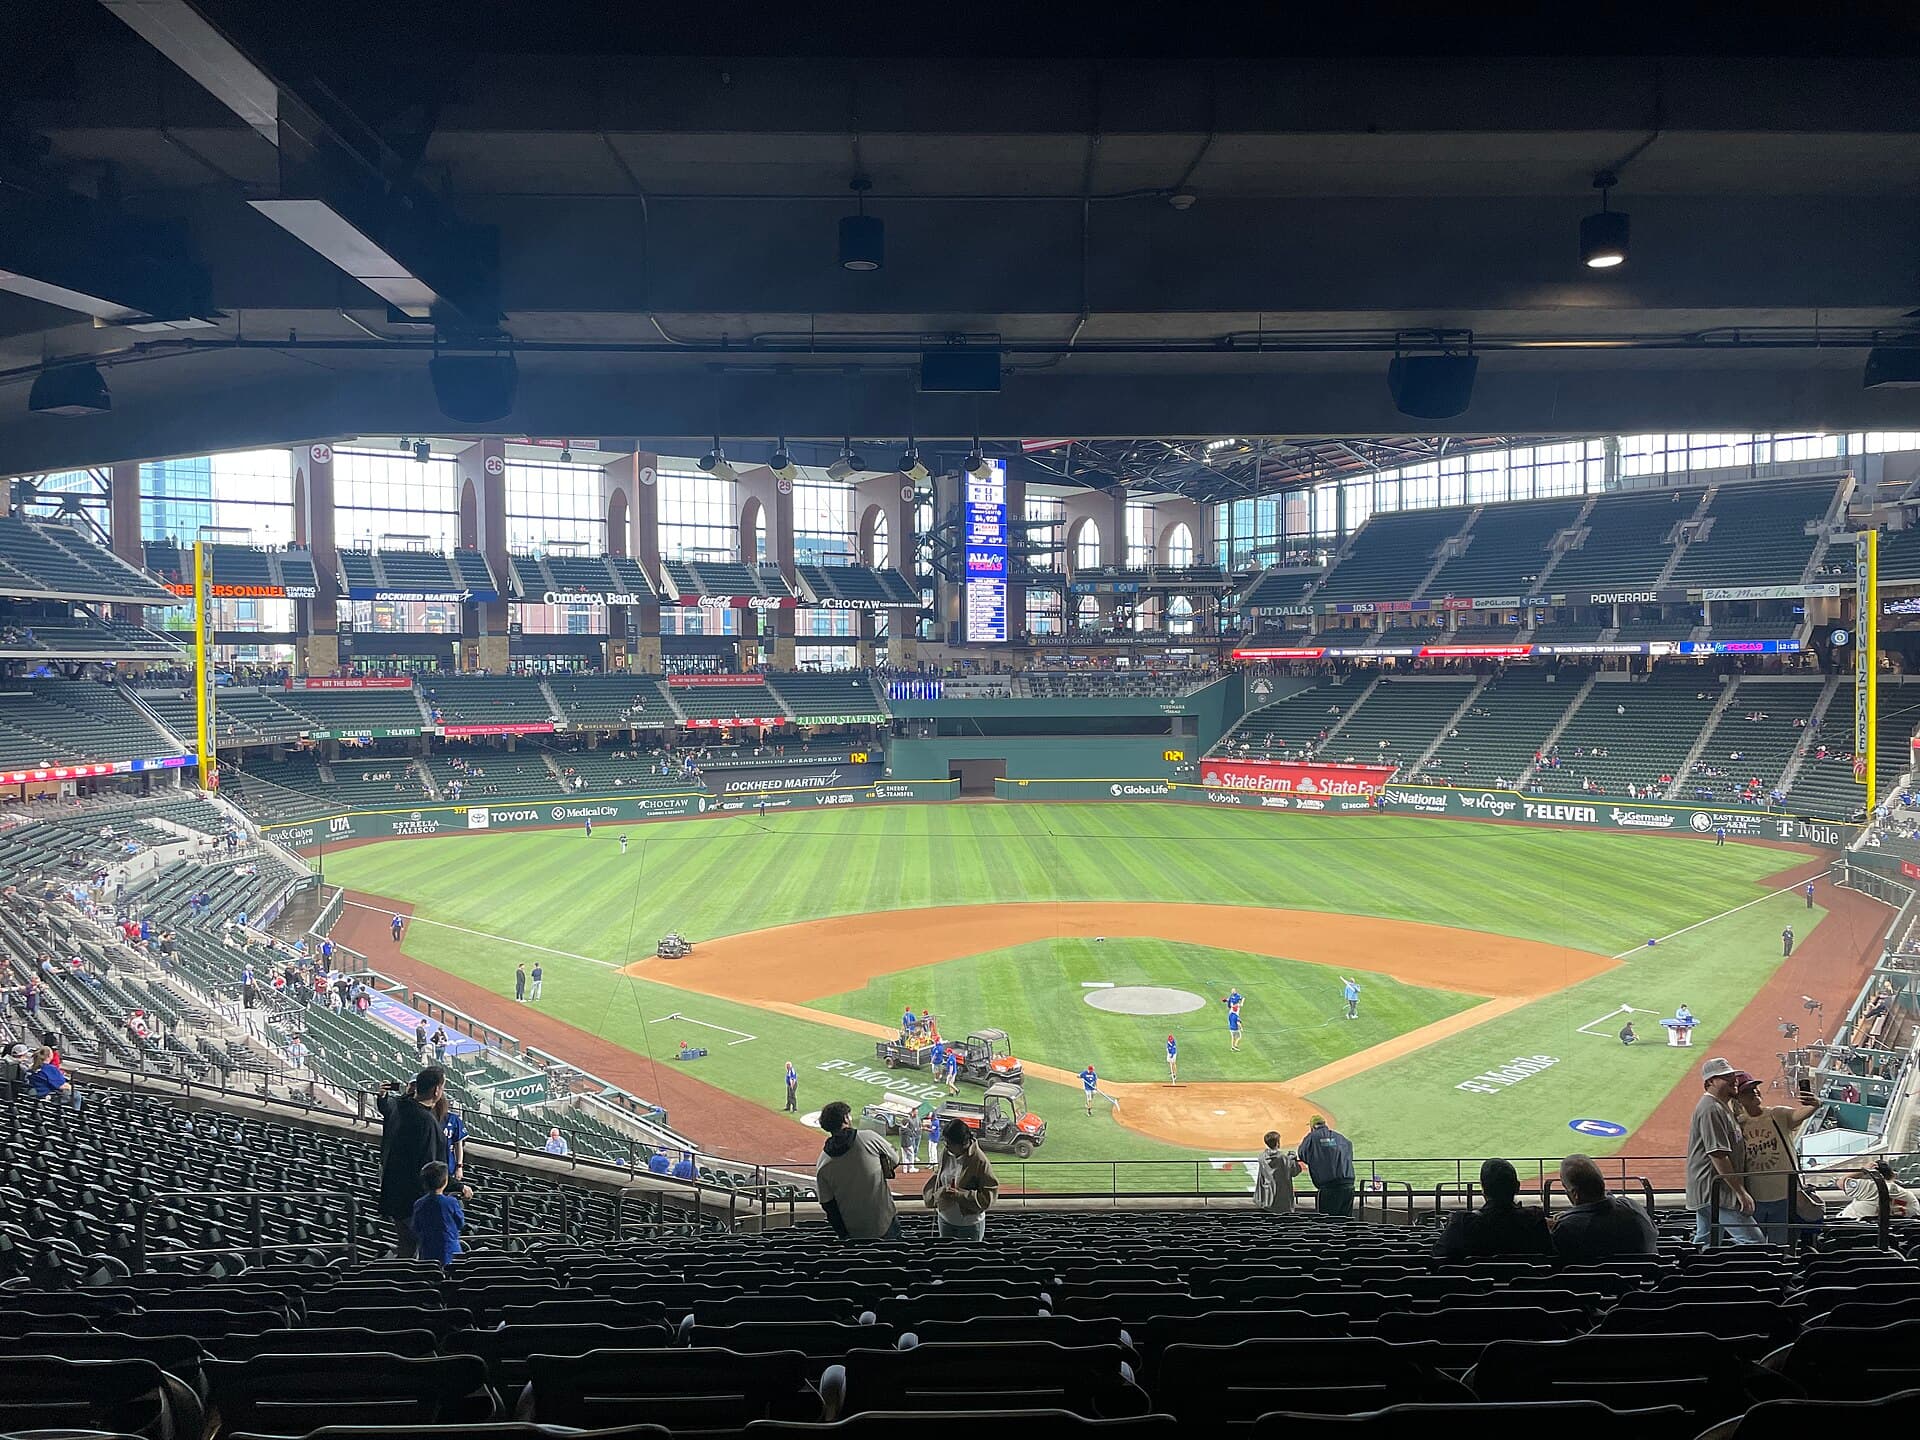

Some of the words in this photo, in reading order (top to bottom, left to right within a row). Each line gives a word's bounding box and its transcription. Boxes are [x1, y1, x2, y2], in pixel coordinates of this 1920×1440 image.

[313, 448, 330, 460] 34
[487, 460, 502, 471] 26
[644, 470, 652, 482] 7
[778, 481, 792, 491] 29
[903, 488, 912, 499] 10
[969, 553, 989, 563] ALL
[210, 584, 286, 598] ERSONNEL
[375, 592, 423, 601] LOCKHEED
[424, 593, 460, 602] MARTIN
[606, 592, 640, 605] Bank
[1591, 592, 1657, 604] POWERADE
[828, 598, 881, 609] CHOCTAW
[1352, 604, 1374, 612] 105.3
[1259, 607, 1273, 616] UT
[1276, 605, 1314, 616] DALLAS
[1692, 643, 1714, 652] ALL
[1727, 643, 1764, 651] TEXAS
[805, 715, 839, 725] LUXOR
[840, 714, 885, 724] STAFFING
[342, 730, 373, 738] 7-ELEVEN
[386, 729, 416, 737] 7-ELEVEN
[725, 779, 783, 793] LOCKHEED
[784, 776, 826, 789] MARTIN
[643, 799, 689, 808] CHOCTAW
[824, 796, 838, 805] AIR
[1208, 792, 1241, 804] Kubota
[1476, 793, 1516, 817] Kroger
[490, 810, 539, 822] TOYOTA
[566, 806, 600, 818] Medical
[600, 805, 619, 818] City
[1626, 811, 1676, 824] Germania
[1713, 813, 1734, 821] EAST
[1735, 815, 1761, 823] TEXAS
[329, 816, 350, 833] UTA
[392, 819, 440, 829] ESTRELLA
[1726, 821, 1748, 829] A&M
[396, 826, 436, 835] JALISCO
[498, 1082, 544, 1100] TOYOTA
